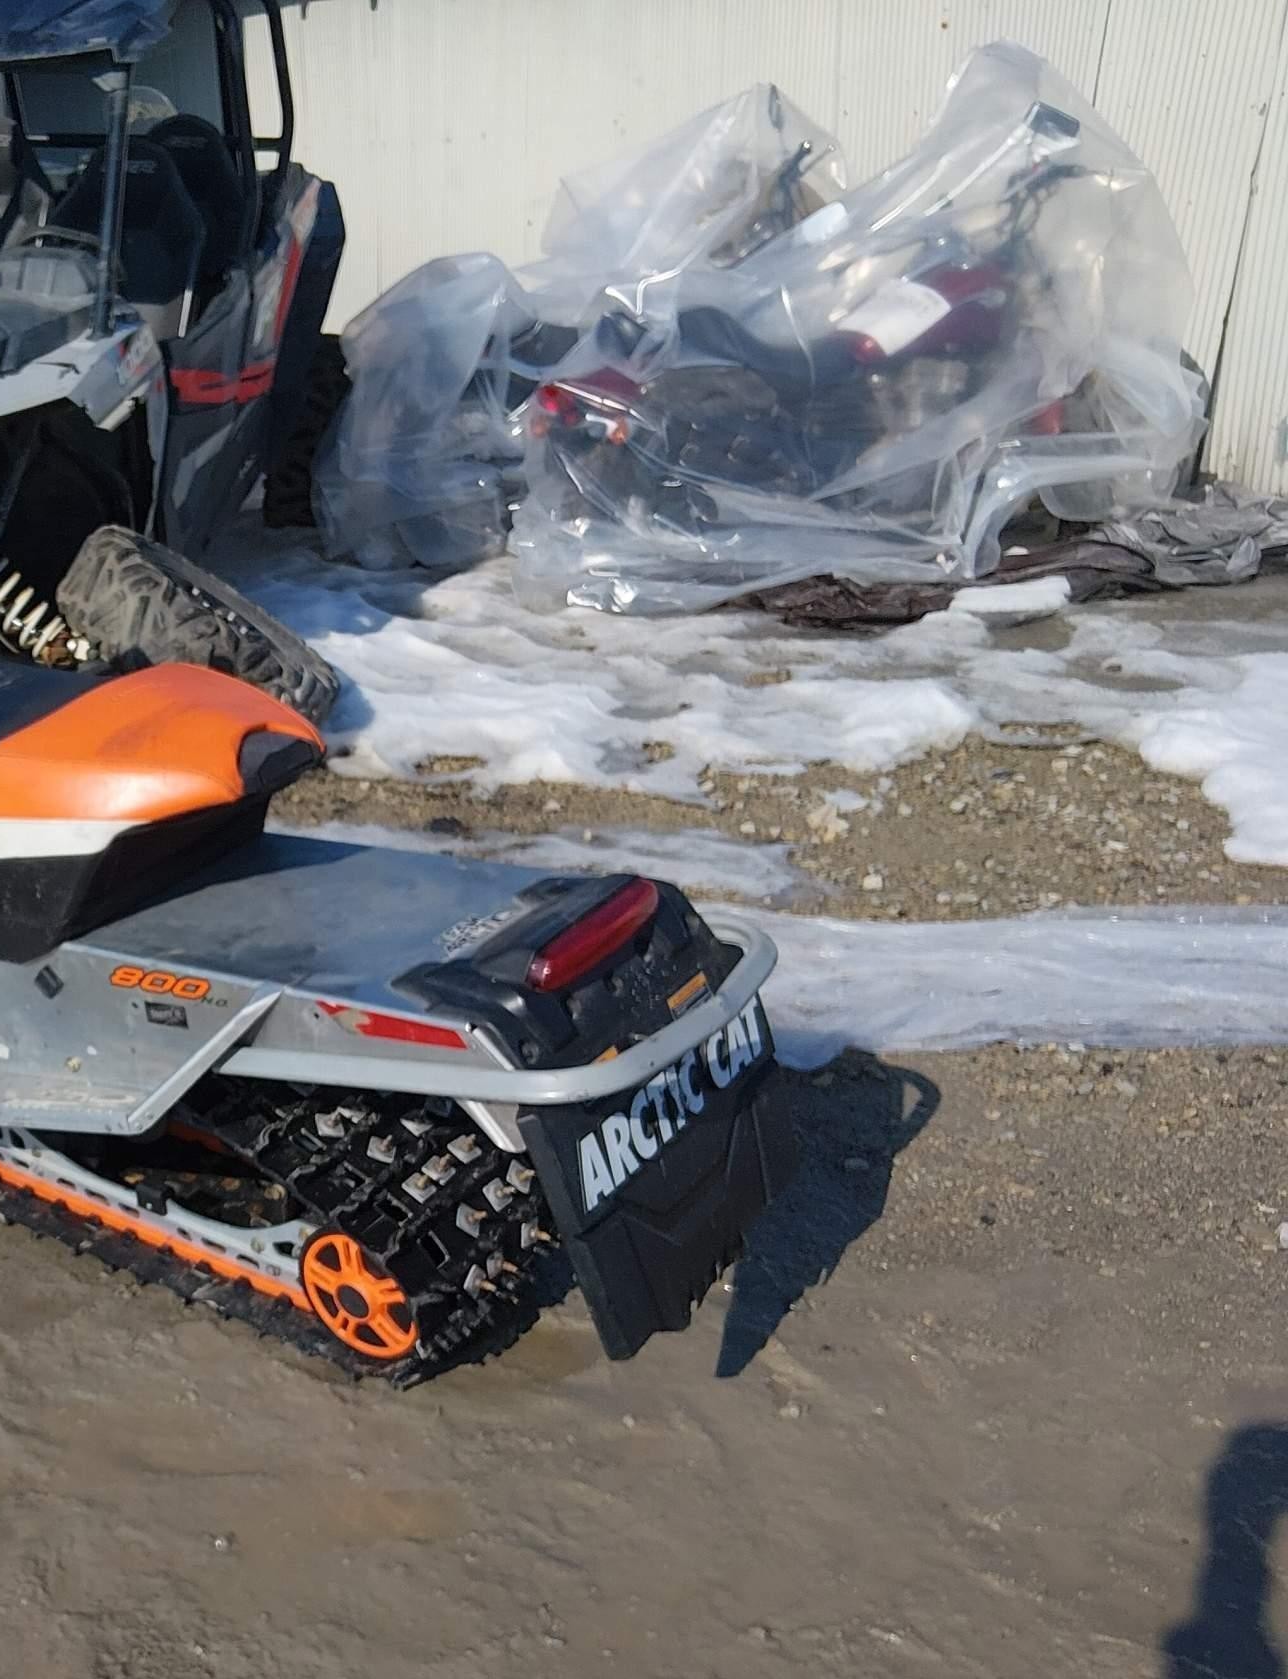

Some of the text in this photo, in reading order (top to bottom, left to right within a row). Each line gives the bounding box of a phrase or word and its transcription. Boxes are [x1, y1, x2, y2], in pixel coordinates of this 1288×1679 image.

[110, 964, 210, 1000] 800
[577, 996, 763, 1214] ARCTIC CAT
